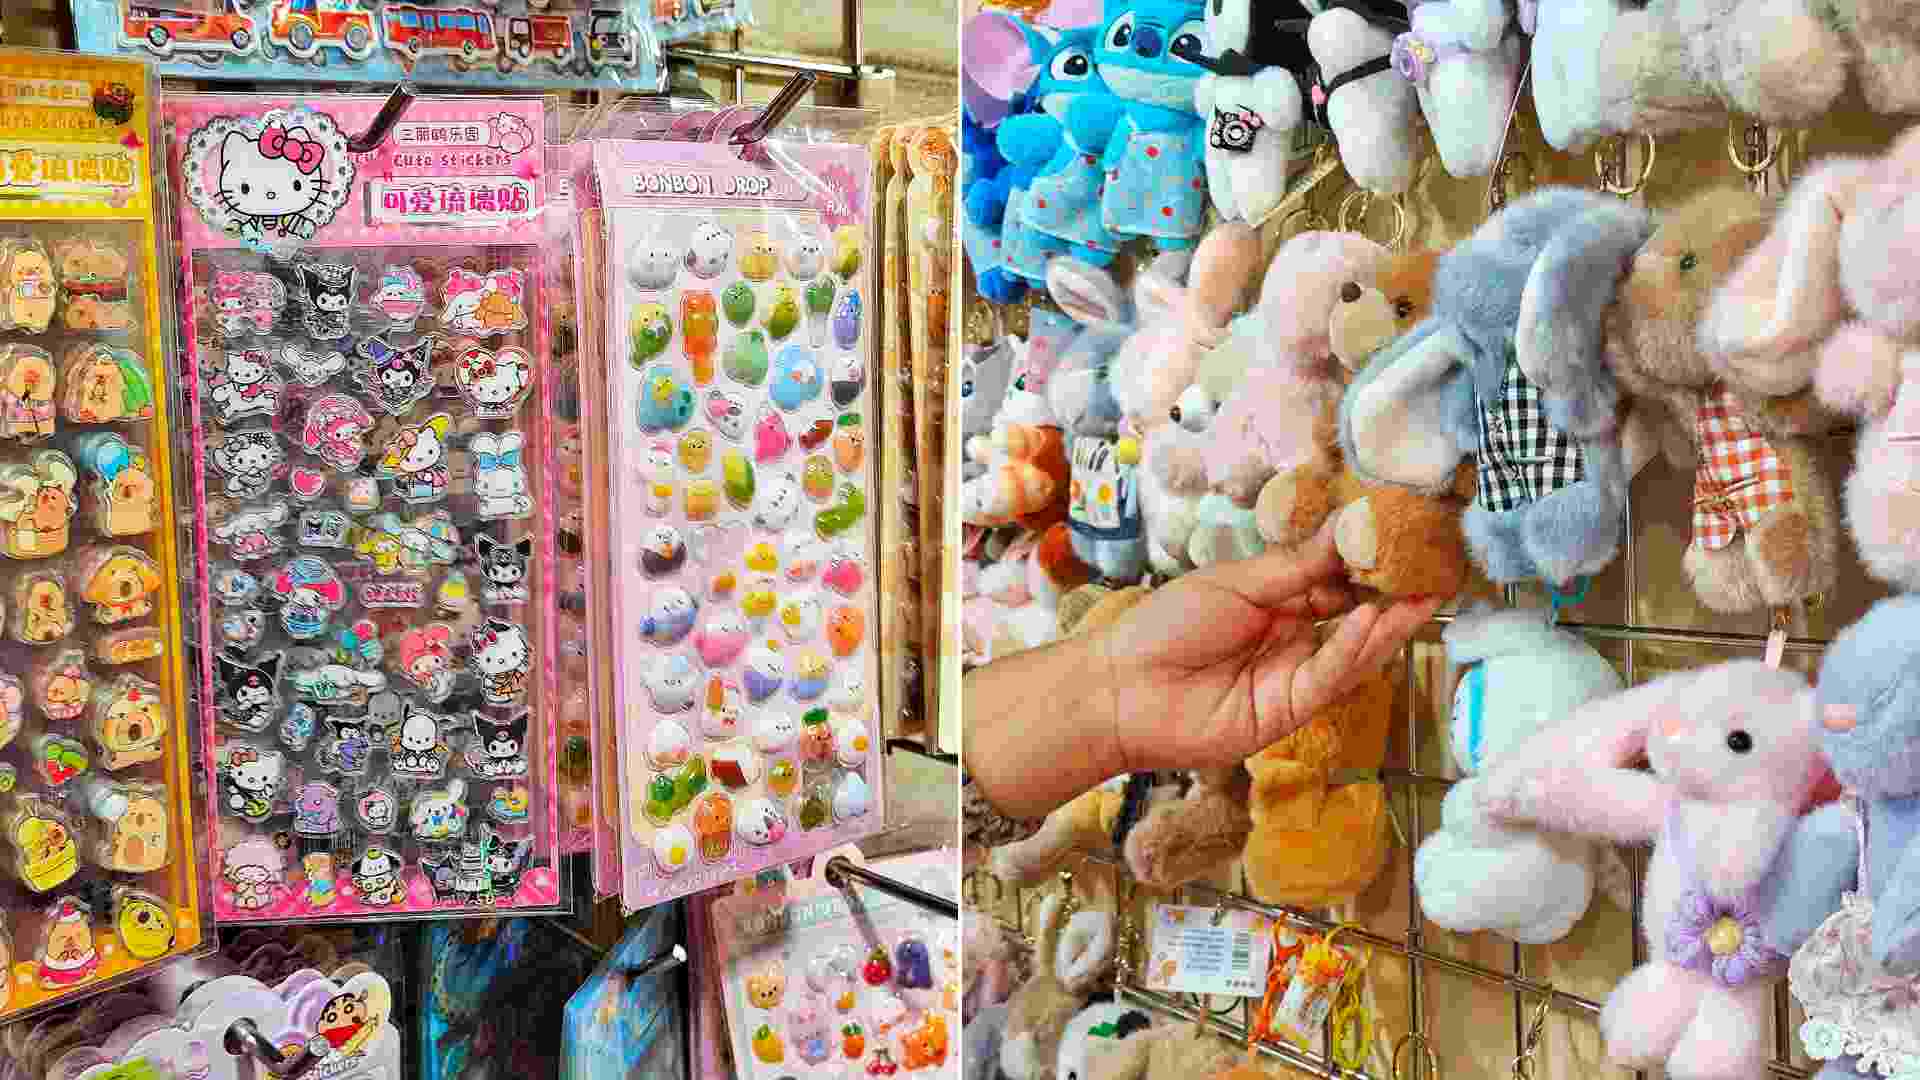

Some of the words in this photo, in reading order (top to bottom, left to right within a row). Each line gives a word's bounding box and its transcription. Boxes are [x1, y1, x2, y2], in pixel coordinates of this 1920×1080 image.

[633, 173, 714, 195] BONBON
[383, 185, 529, 213] 可爱琉璃贴
